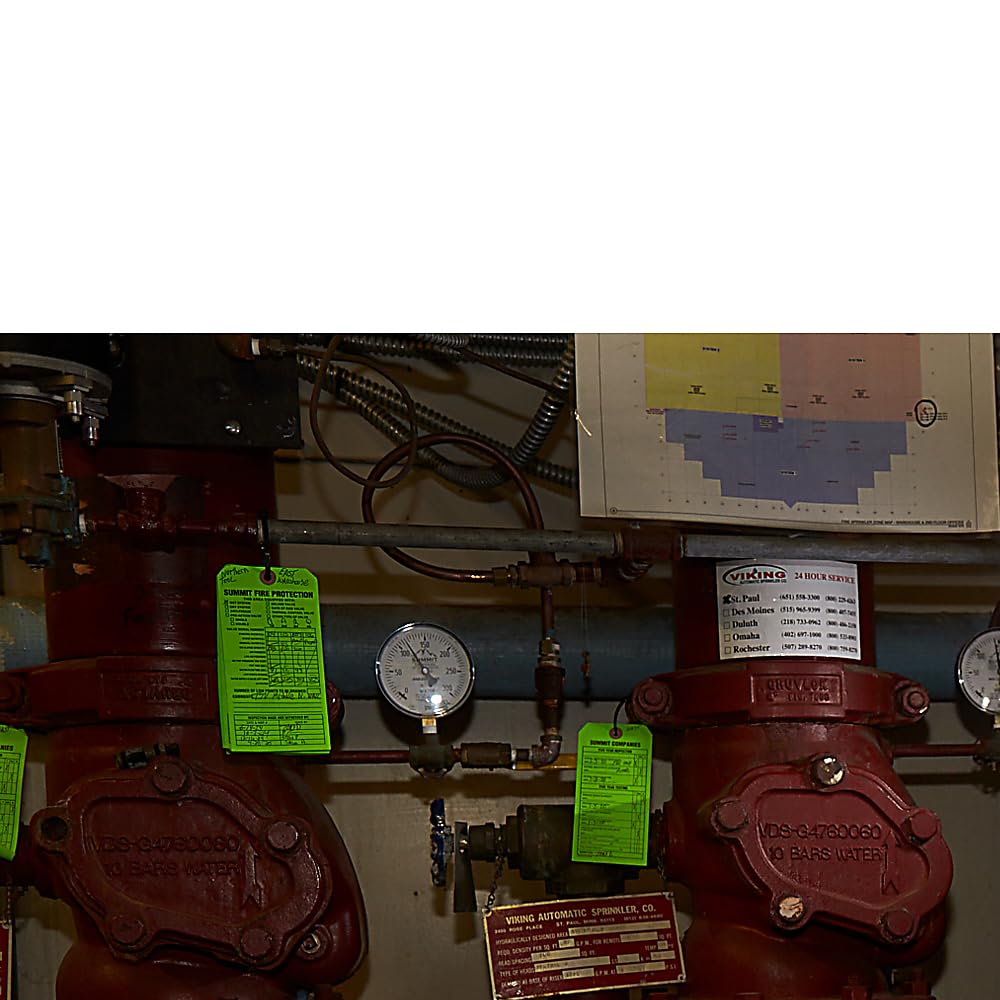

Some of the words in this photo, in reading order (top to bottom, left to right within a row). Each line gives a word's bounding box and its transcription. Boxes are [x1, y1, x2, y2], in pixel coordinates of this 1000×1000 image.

[730, 572, 786, 580] VIKING
[794, 572, 803, 580] 24
[828, 575, 856, 584] SERVICE
[224, 589, 253, 597] SUMMIT
[732, 608, 745, 616] Des
[732, 620, 758, 628] Duluth
[733, 632, 760, 641] Omaha
[733, 645, 770, 653] Rochester
[791, 846, 831, 861] BARS
[836, 848, 883, 861] WATER
[506, 914, 535, 925] VIKING
[538, 909, 587, 921] AUTOMATIC
[592, 905, 639, 917] SPRINKLER,
[642, 904, 656, 912] CO.
